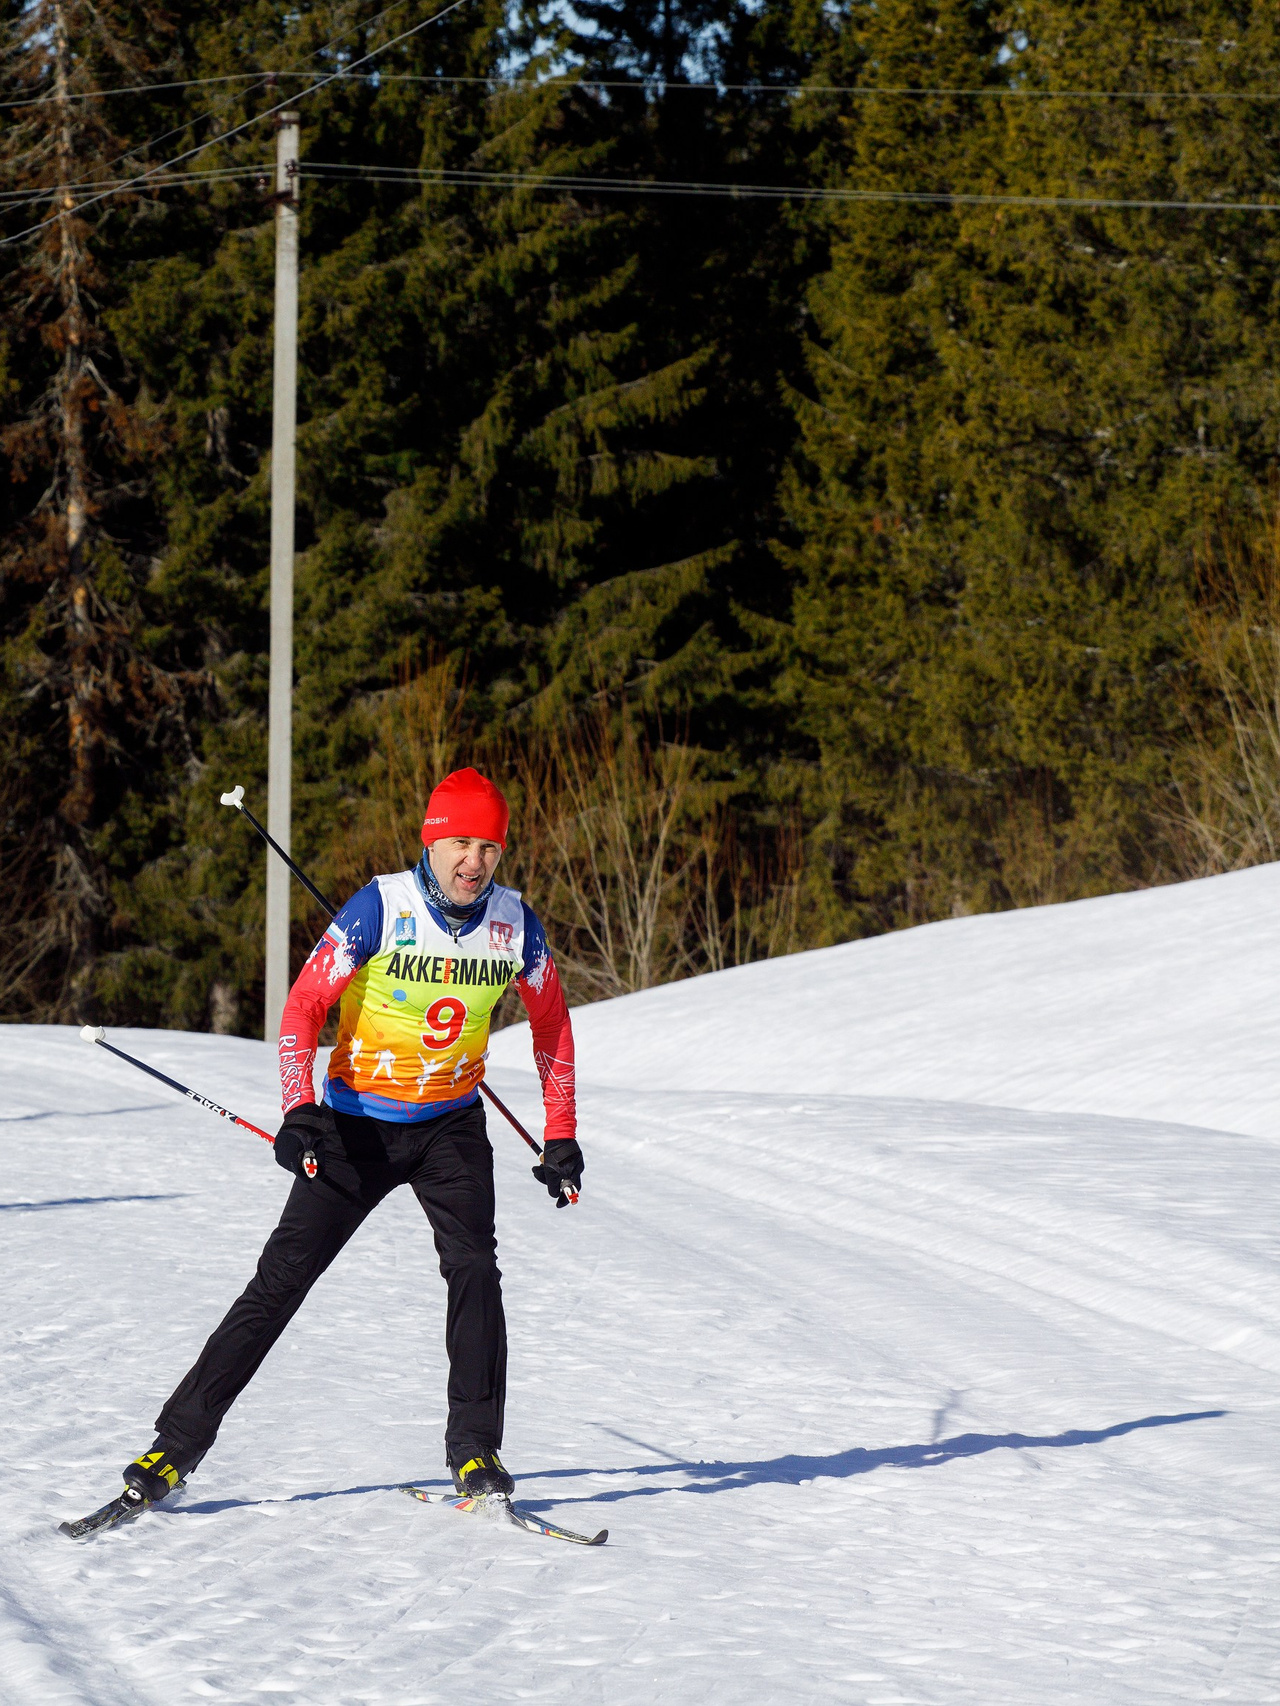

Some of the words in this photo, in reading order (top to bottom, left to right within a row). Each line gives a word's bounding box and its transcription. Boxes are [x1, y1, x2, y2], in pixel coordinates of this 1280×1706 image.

[385, 952, 514, 987] AKKERMANN
[442, 958, 453, 984] cement
[420, 996, 468, 1051] 9
